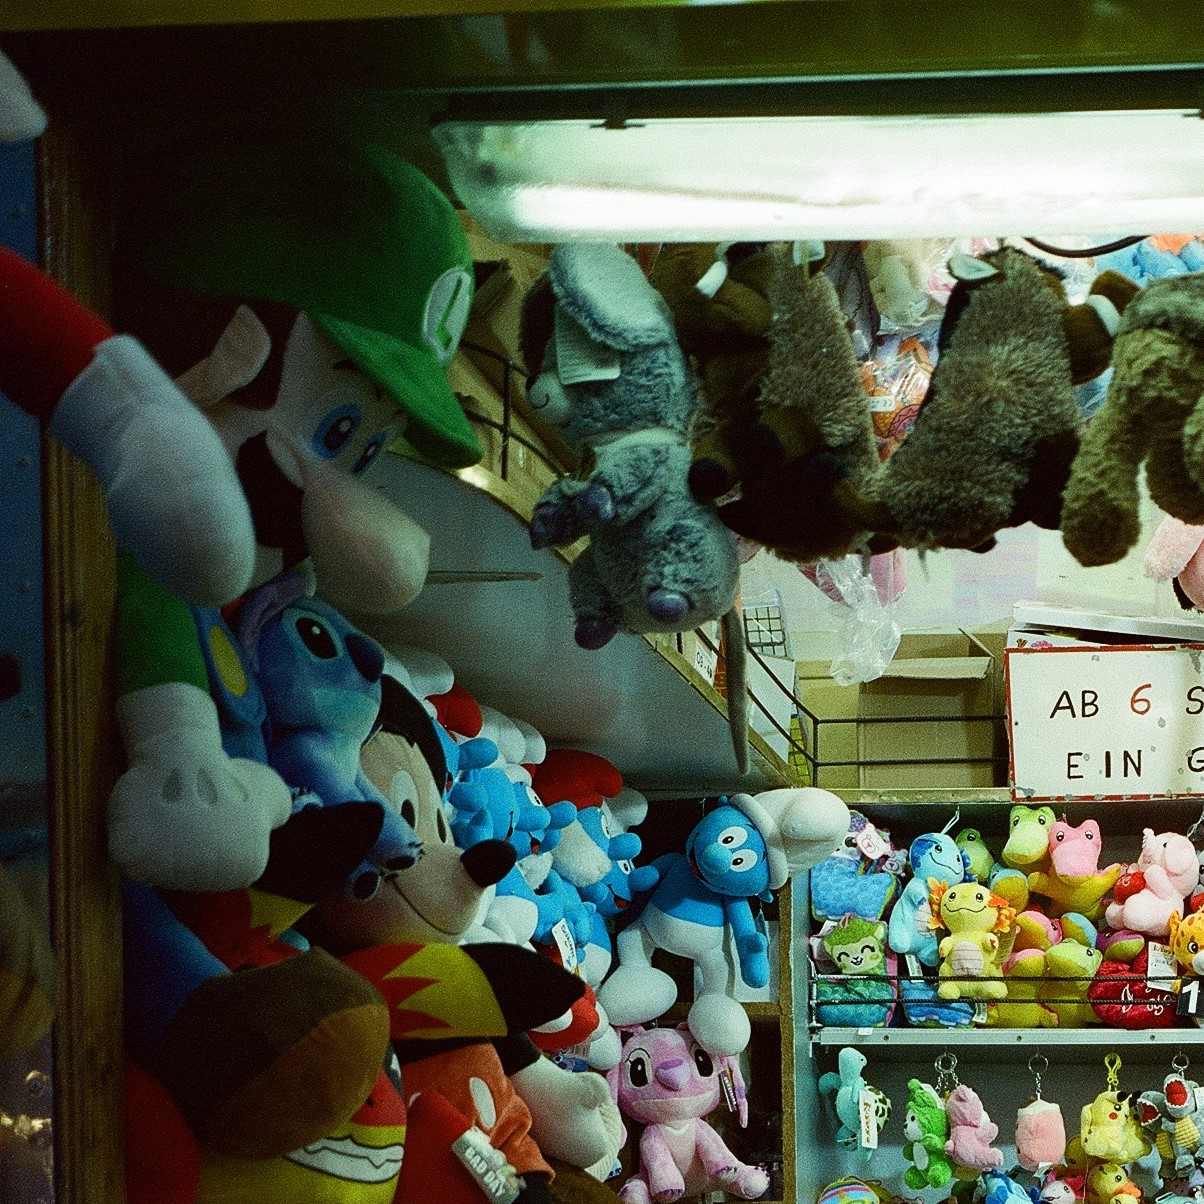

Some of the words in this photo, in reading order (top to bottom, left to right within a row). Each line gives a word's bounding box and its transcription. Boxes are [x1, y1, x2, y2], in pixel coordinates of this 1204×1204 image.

[1050, 690, 1100, 719] AB
[1130, 683, 1153, 716] 6
[1067, 749, 1144, 780] EIN
